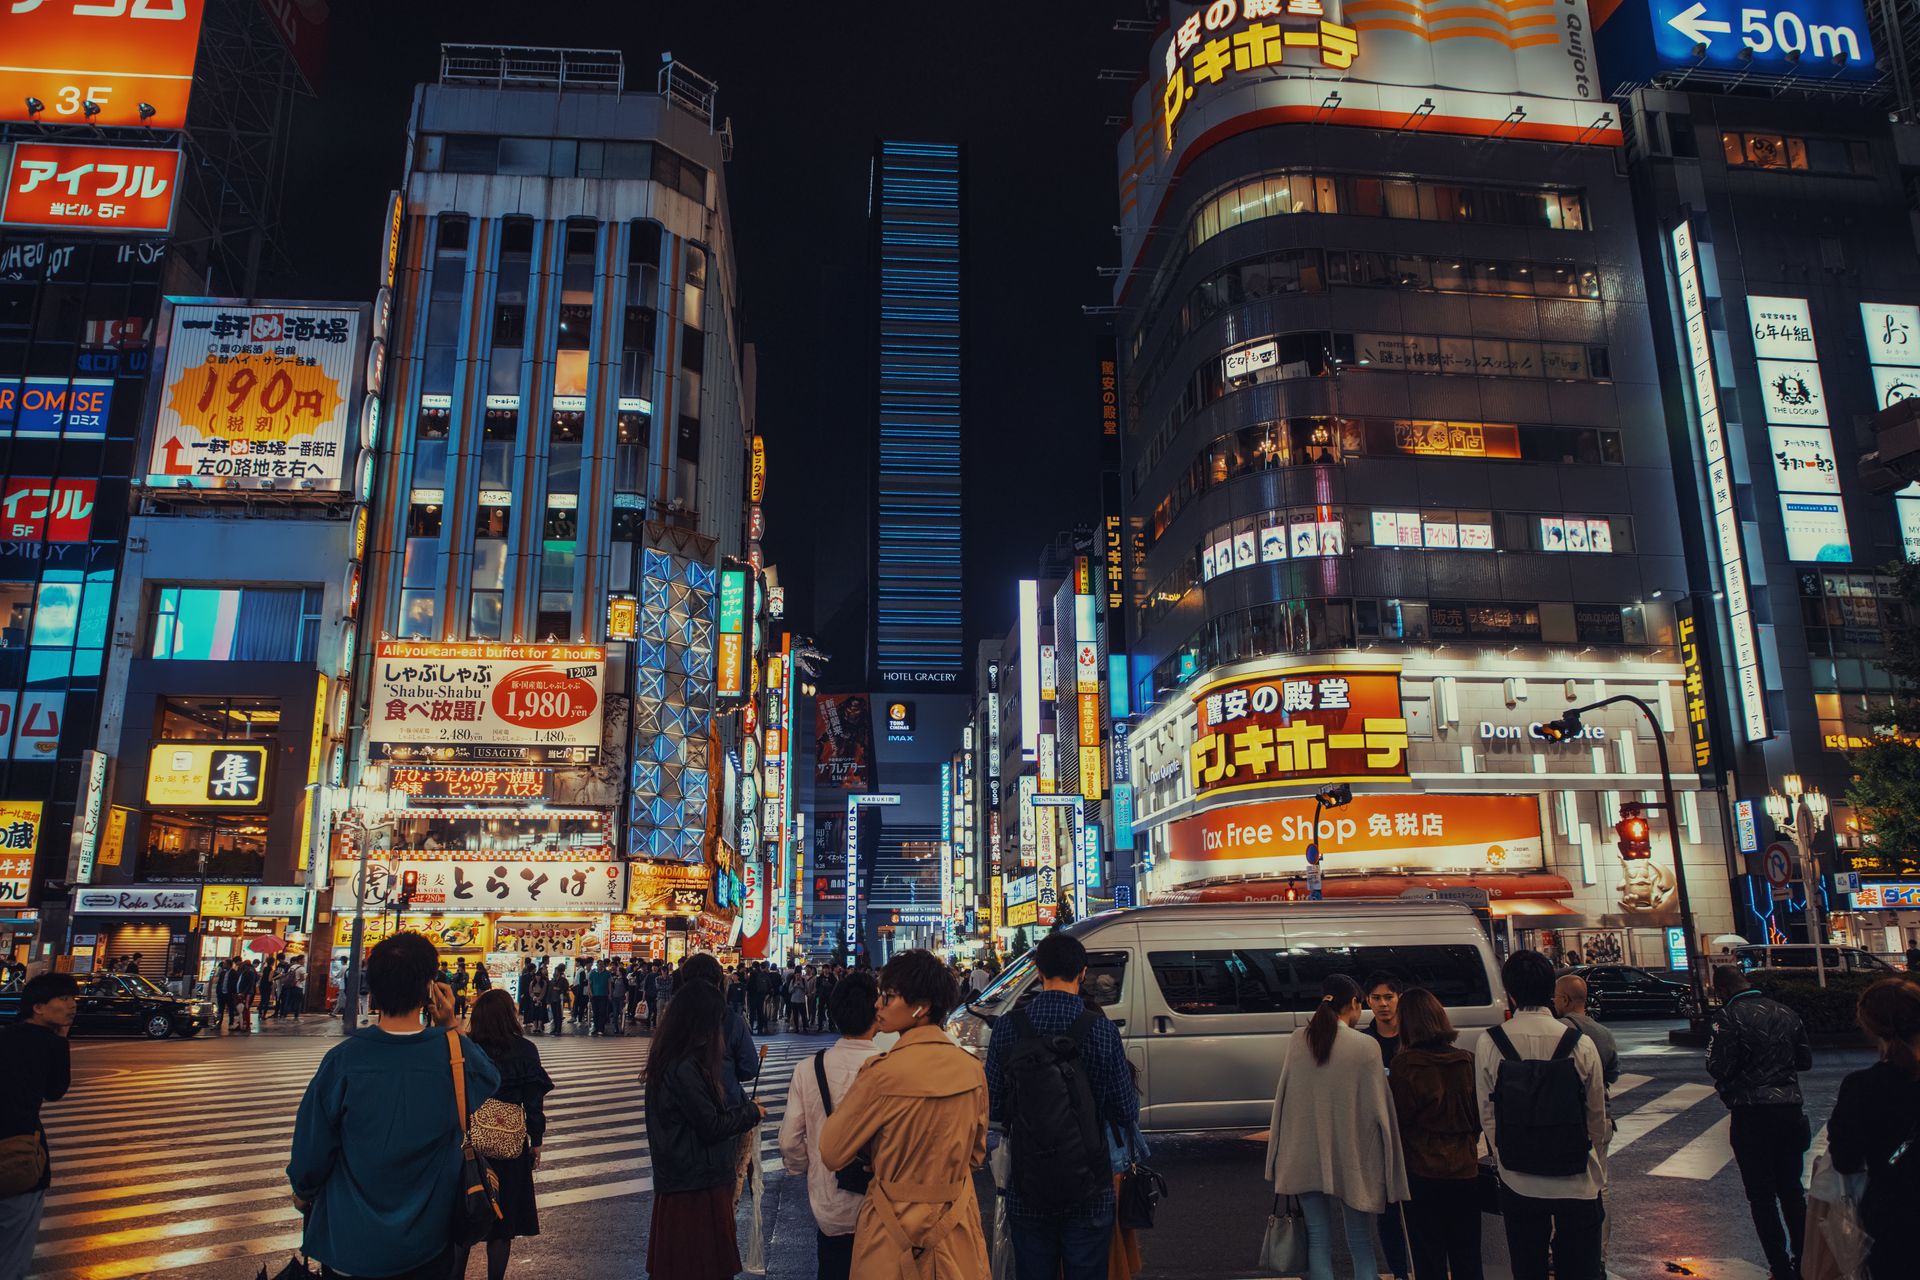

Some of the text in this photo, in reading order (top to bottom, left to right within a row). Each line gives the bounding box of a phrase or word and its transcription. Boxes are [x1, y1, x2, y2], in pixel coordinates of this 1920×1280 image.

[1741, 8, 1861, 61] 50m
[1570, 15, 1589, 100] Quijote
[55, 85, 113, 115] 3F
[19, 159, 168, 198] アイフル
[49, 202, 126, 218] 当ビル 5F
[1755, 323, 1812, 342] 6年4組
[197, 367, 325, 418] 190円
[1101, 360, 1118, 436] 驚安の殿堂
[53, 413, 100, 426] プロミス
[1789, 407, 1819, 416] LOCKUP
[197, 457, 324, 478] 左の路地を右へ
[12, 524, 34, 538] 5F
[383, 645, 601, 660] All-you-can-eat buffet for 2 hours
[385, 663, 492, 683] しゃぶしゃぶ
[883, 672, 957, 681] HOTEL GRACERY
[384, 699, 486, 721] 食べ放題!
[504, 690, 587, 720] 1,980 yen
[1206, 677, 1350, 727] 驚安の殿堂
[440, 728, 483, 742] 2,480 yen
[534, 729, 564, 742] 1,480
[1481, 726, 1521, 742] Don
[572, 747, 596, 761] 5F
[1191, 717, 1409, 789] ドン・キホーテ
[210, 753, 256, 796] 集
[817, 762, 866, 774] ザ・プレデター
[1150, 769, 1160, 783] Don
[449, 783, 498, 795] ピッツァ
[505, 783, 543, 796] パスタ
[990, 780, 1000, 805] Booth
[1201, 812, 1444, 851] Tax Free Shop 免税店
[1086, 828, 1097, 888] カラオケ
[634, 865, 711, 878] OKONOMI YAKI
[848, 817, 857, 936] GODZILLA ROAD
[453, 865, 595, 901] とらそば
[745, 866, 755, 909] トラノコ
[118, 892, 185, 910] Roko Shira
[224, 890, 243, 912] 集
[1884, 886, 1920, 905] ダイ
[900, 915, 942, 923] TOHO CINEM
